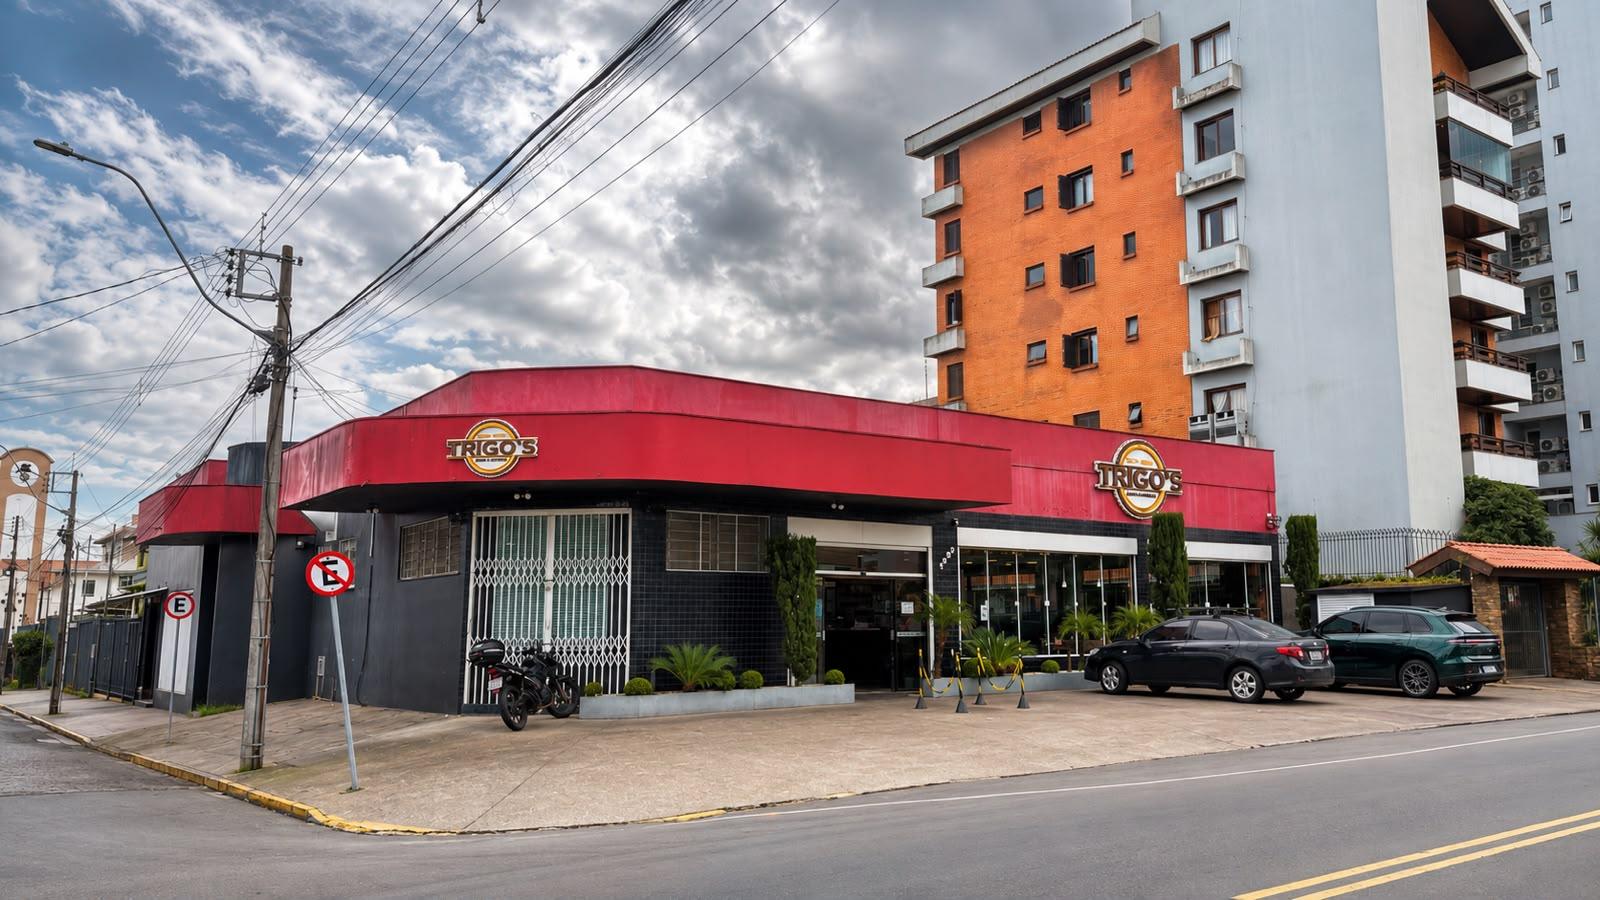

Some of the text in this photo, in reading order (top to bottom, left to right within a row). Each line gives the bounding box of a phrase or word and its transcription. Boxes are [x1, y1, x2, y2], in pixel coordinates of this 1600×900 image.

[447, 439, 537, 457] TRIGO'S
[1097, 463, 1183, 492] TRIGO'S
[320, 559, 342, 586] E
[174, 597, 186, 613] E
